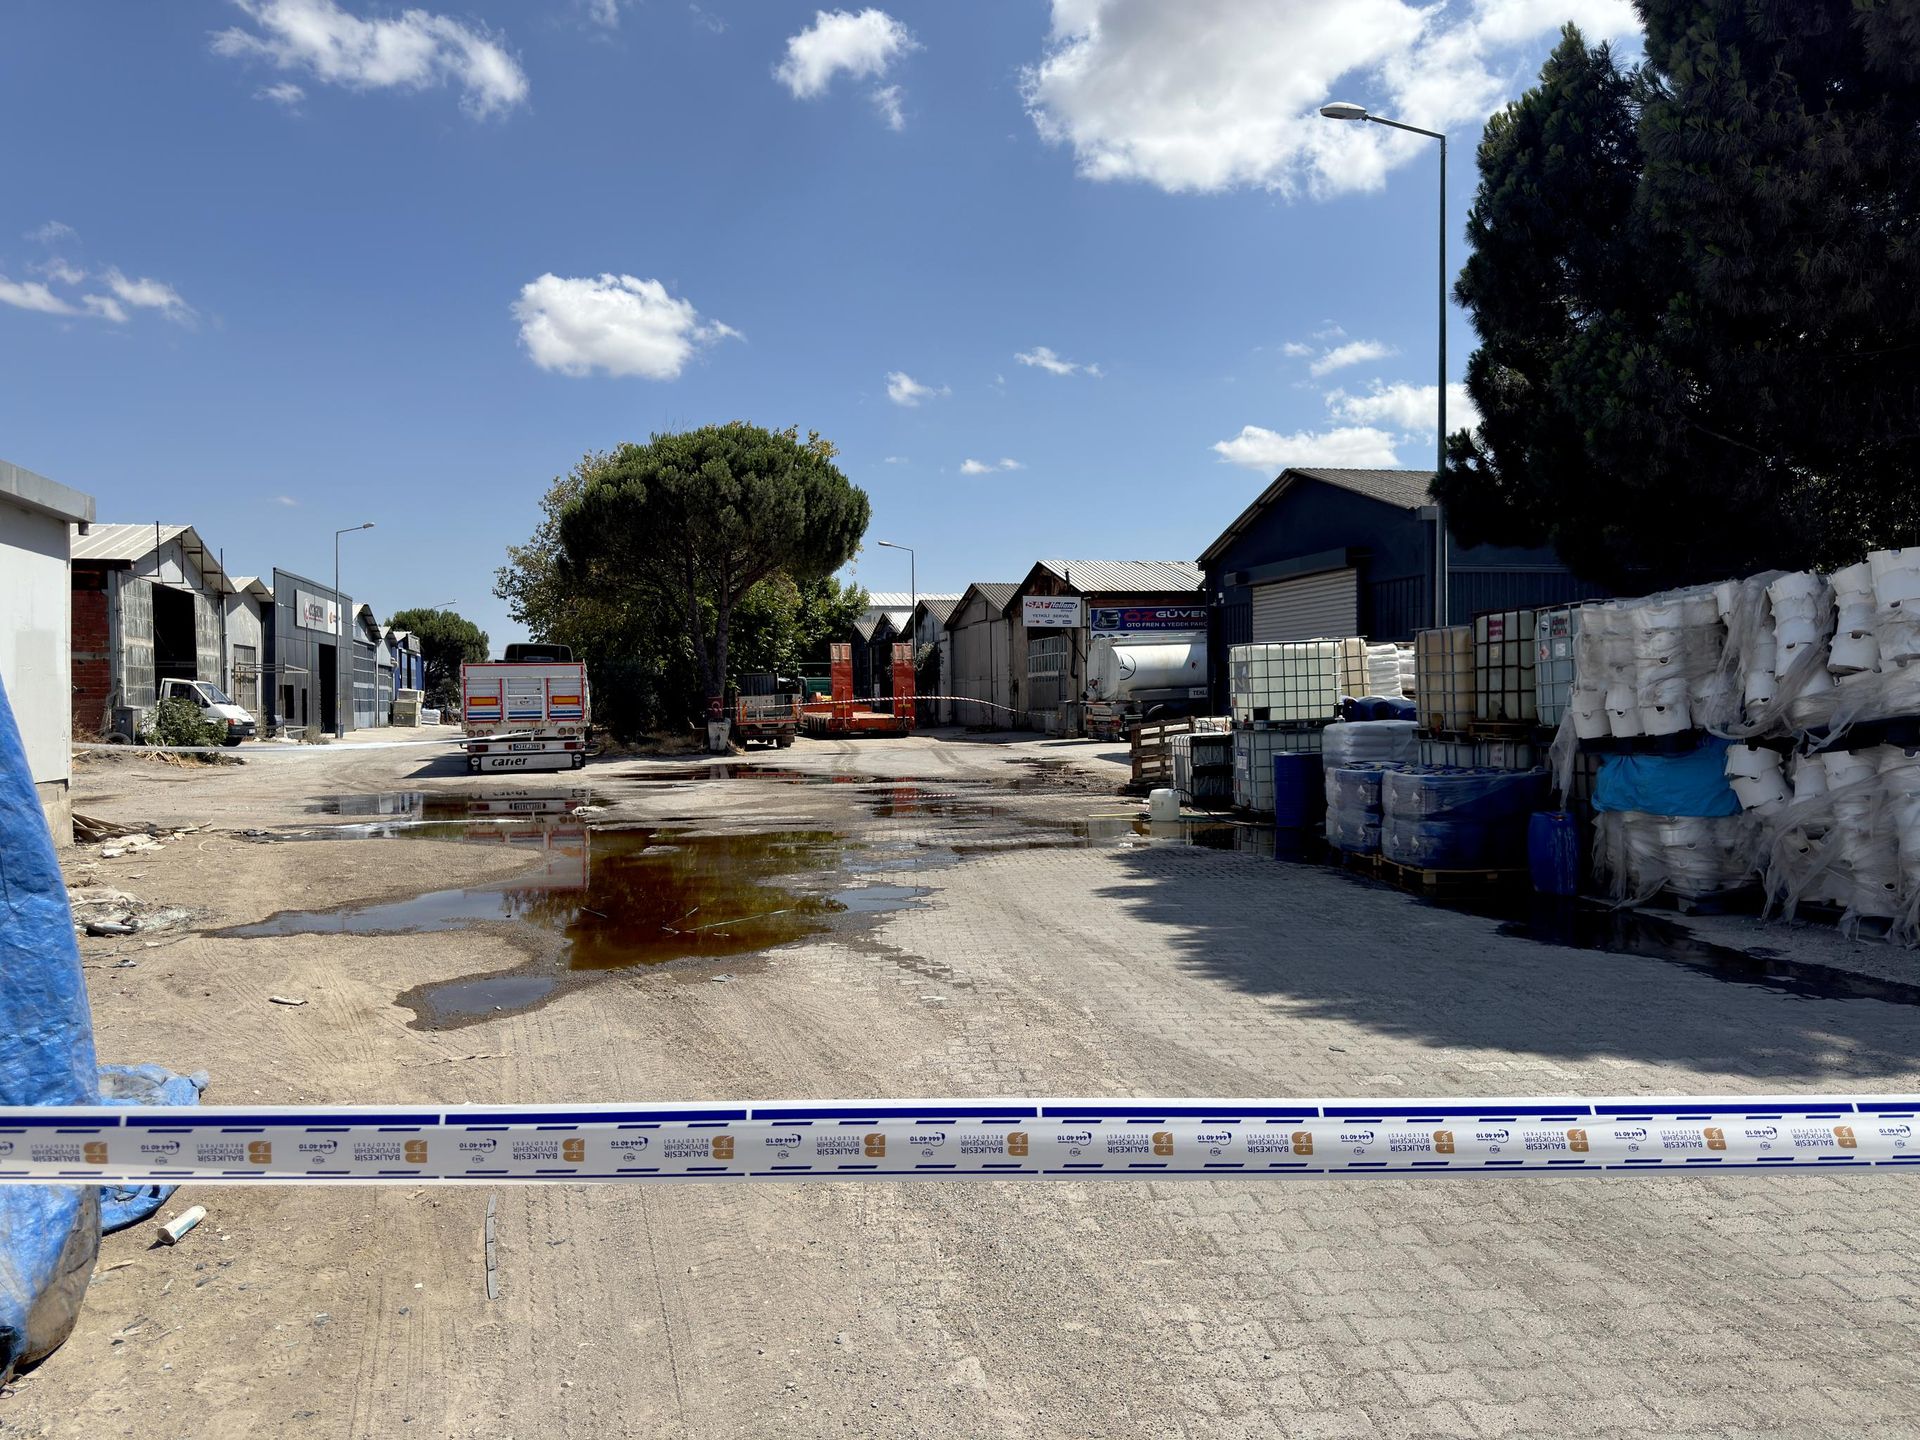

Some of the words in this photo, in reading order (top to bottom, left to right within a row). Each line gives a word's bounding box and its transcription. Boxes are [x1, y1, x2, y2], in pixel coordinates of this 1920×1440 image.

[961, 1145, 1003, 1154] BALIKESİR
[1107, 1145, 1149, 1153] BALIKESİR
[1248, 1145, 1288, 1153] BALIKESİR
[1390, 1144, 1430, 1152] BALIKESİR
[1525, 1142, 1566, 1151] BALIKESİR
[664, 1149, 708, 1158] BALIKESİR
[817, 1147, 859, 1156] BALIKESİR
[197, 1154, 244, 1162] BALIKESİR
[354, 1153, 400, 1161] BALIKESİR
[513, 1152, 558, 1160] BALIKESİR
